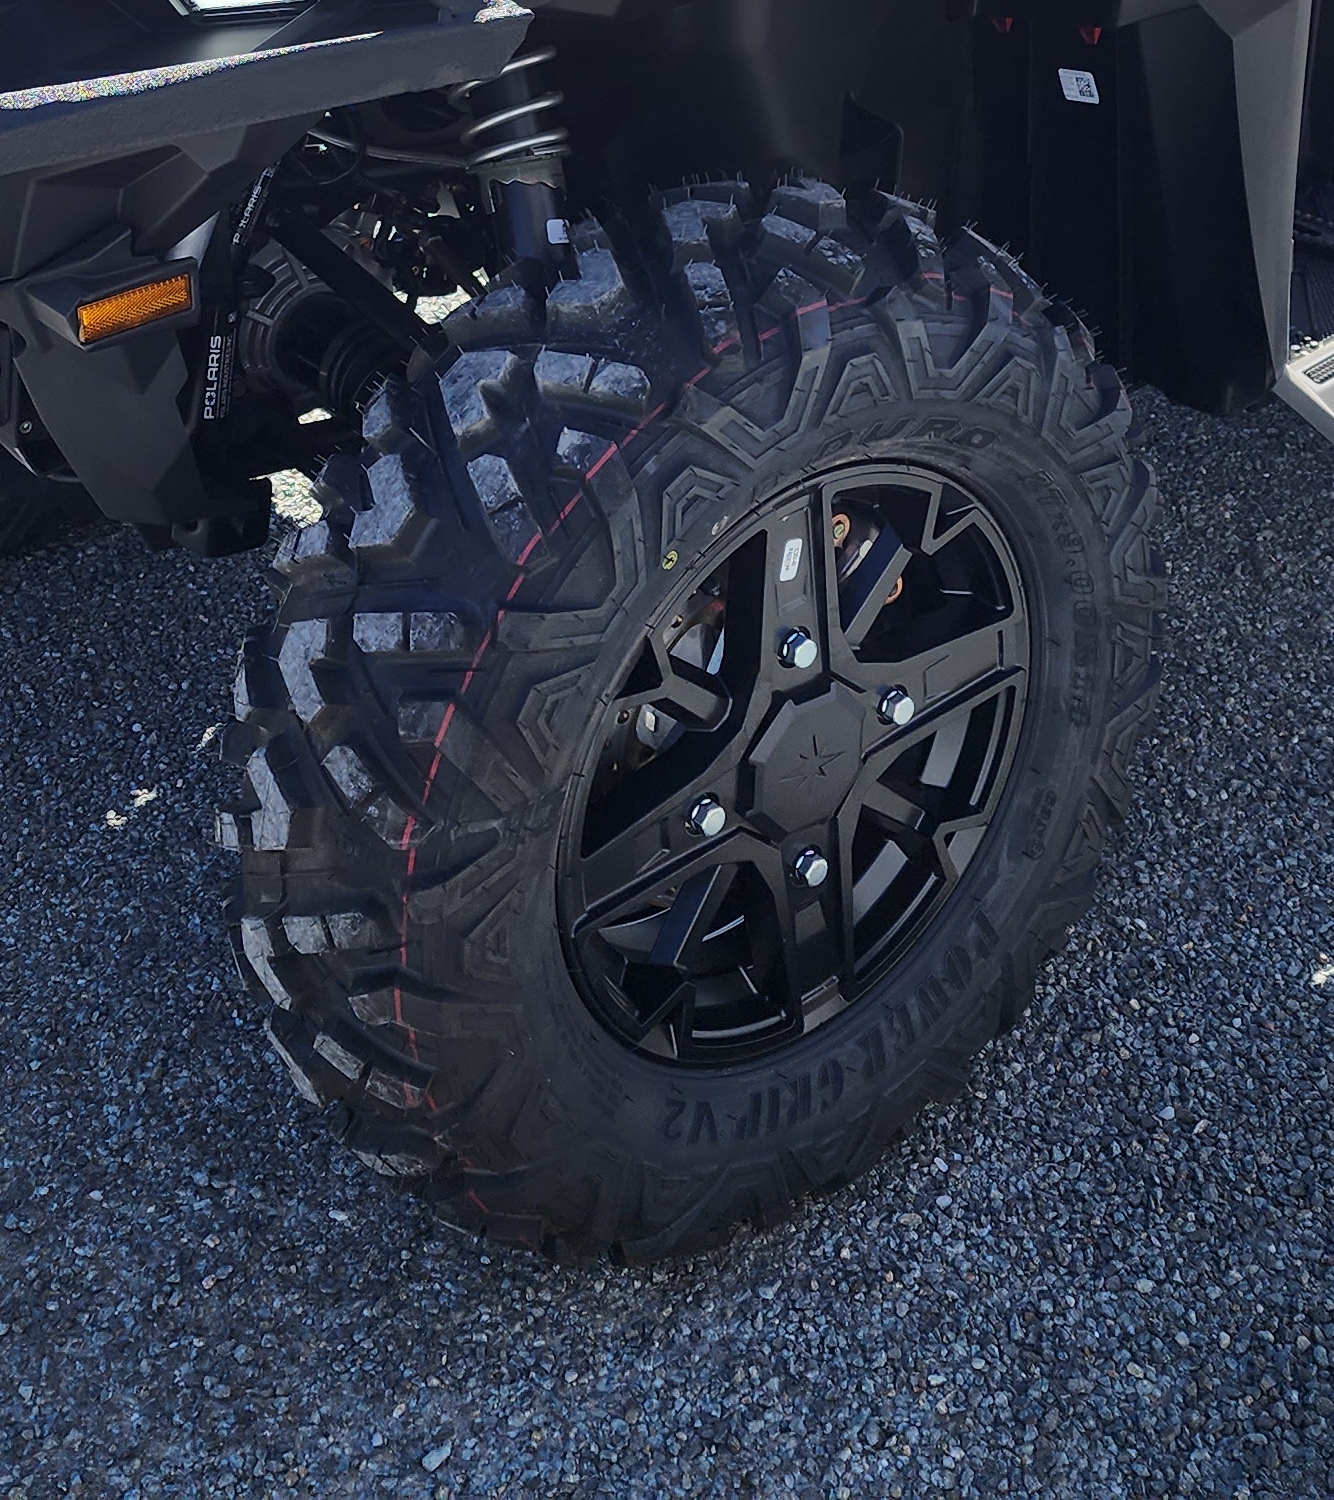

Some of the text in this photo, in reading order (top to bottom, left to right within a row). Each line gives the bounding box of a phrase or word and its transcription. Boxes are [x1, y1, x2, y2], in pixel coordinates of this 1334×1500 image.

[203, 334, 223, 420] POLARIS
[816, 417, 1000, 459] DURO
[662, 906, 1001, 1145] POWER GRIP V2
